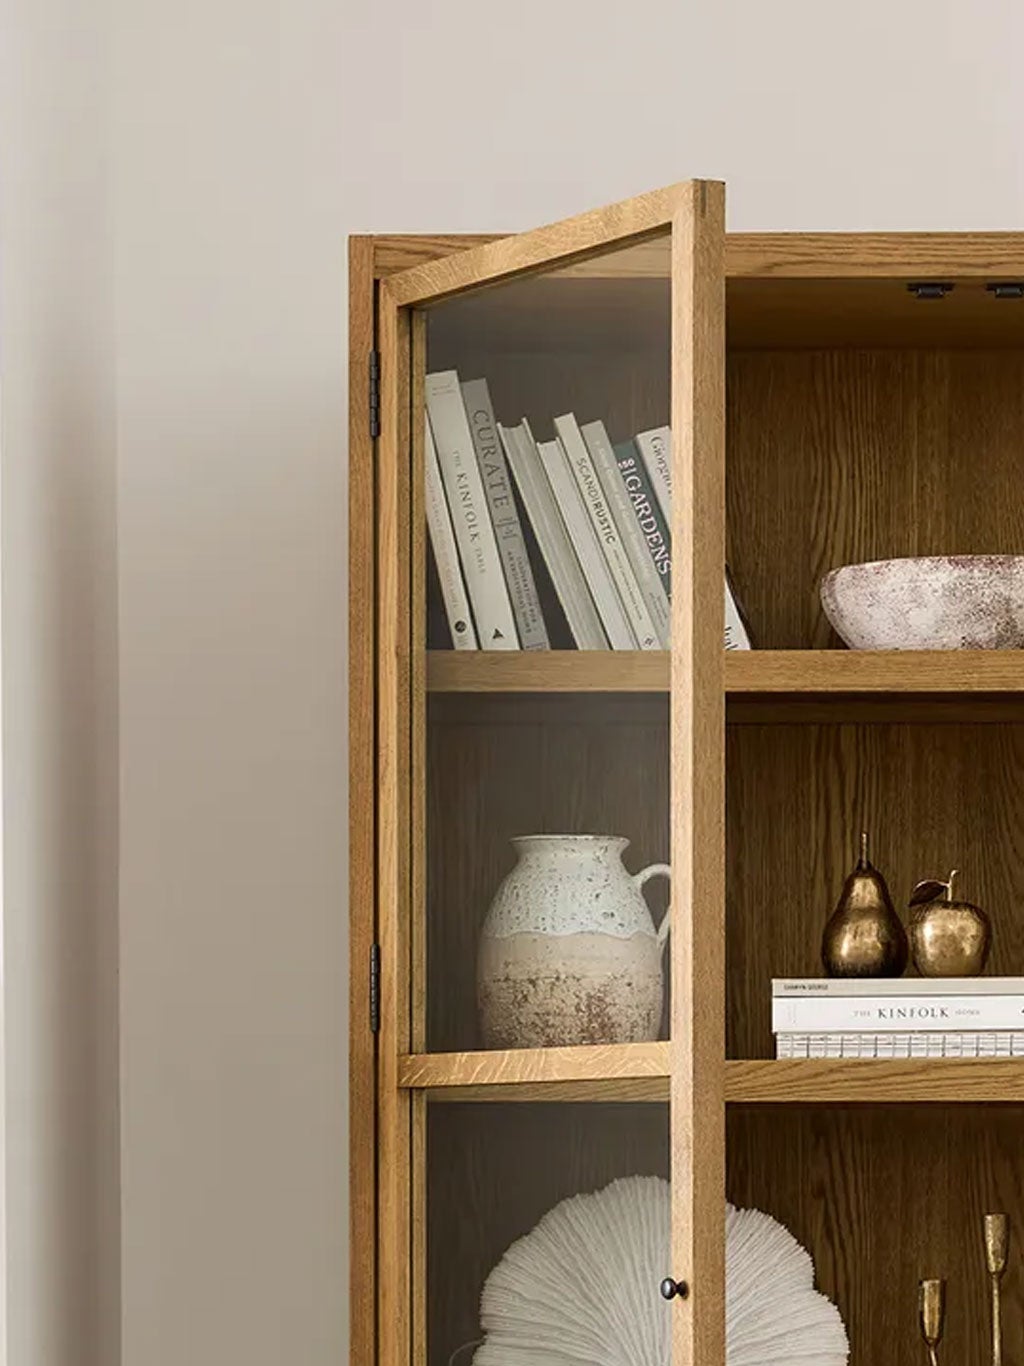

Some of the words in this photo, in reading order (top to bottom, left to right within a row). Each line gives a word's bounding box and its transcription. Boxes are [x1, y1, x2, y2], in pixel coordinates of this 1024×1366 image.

[474, 409, 509, 508] CURATE
[457, 473, 479, 542] KINFOLK
[625, 475, 672, 575] GARDENS
[878, 1007, 949, 1019] KINFOLK
